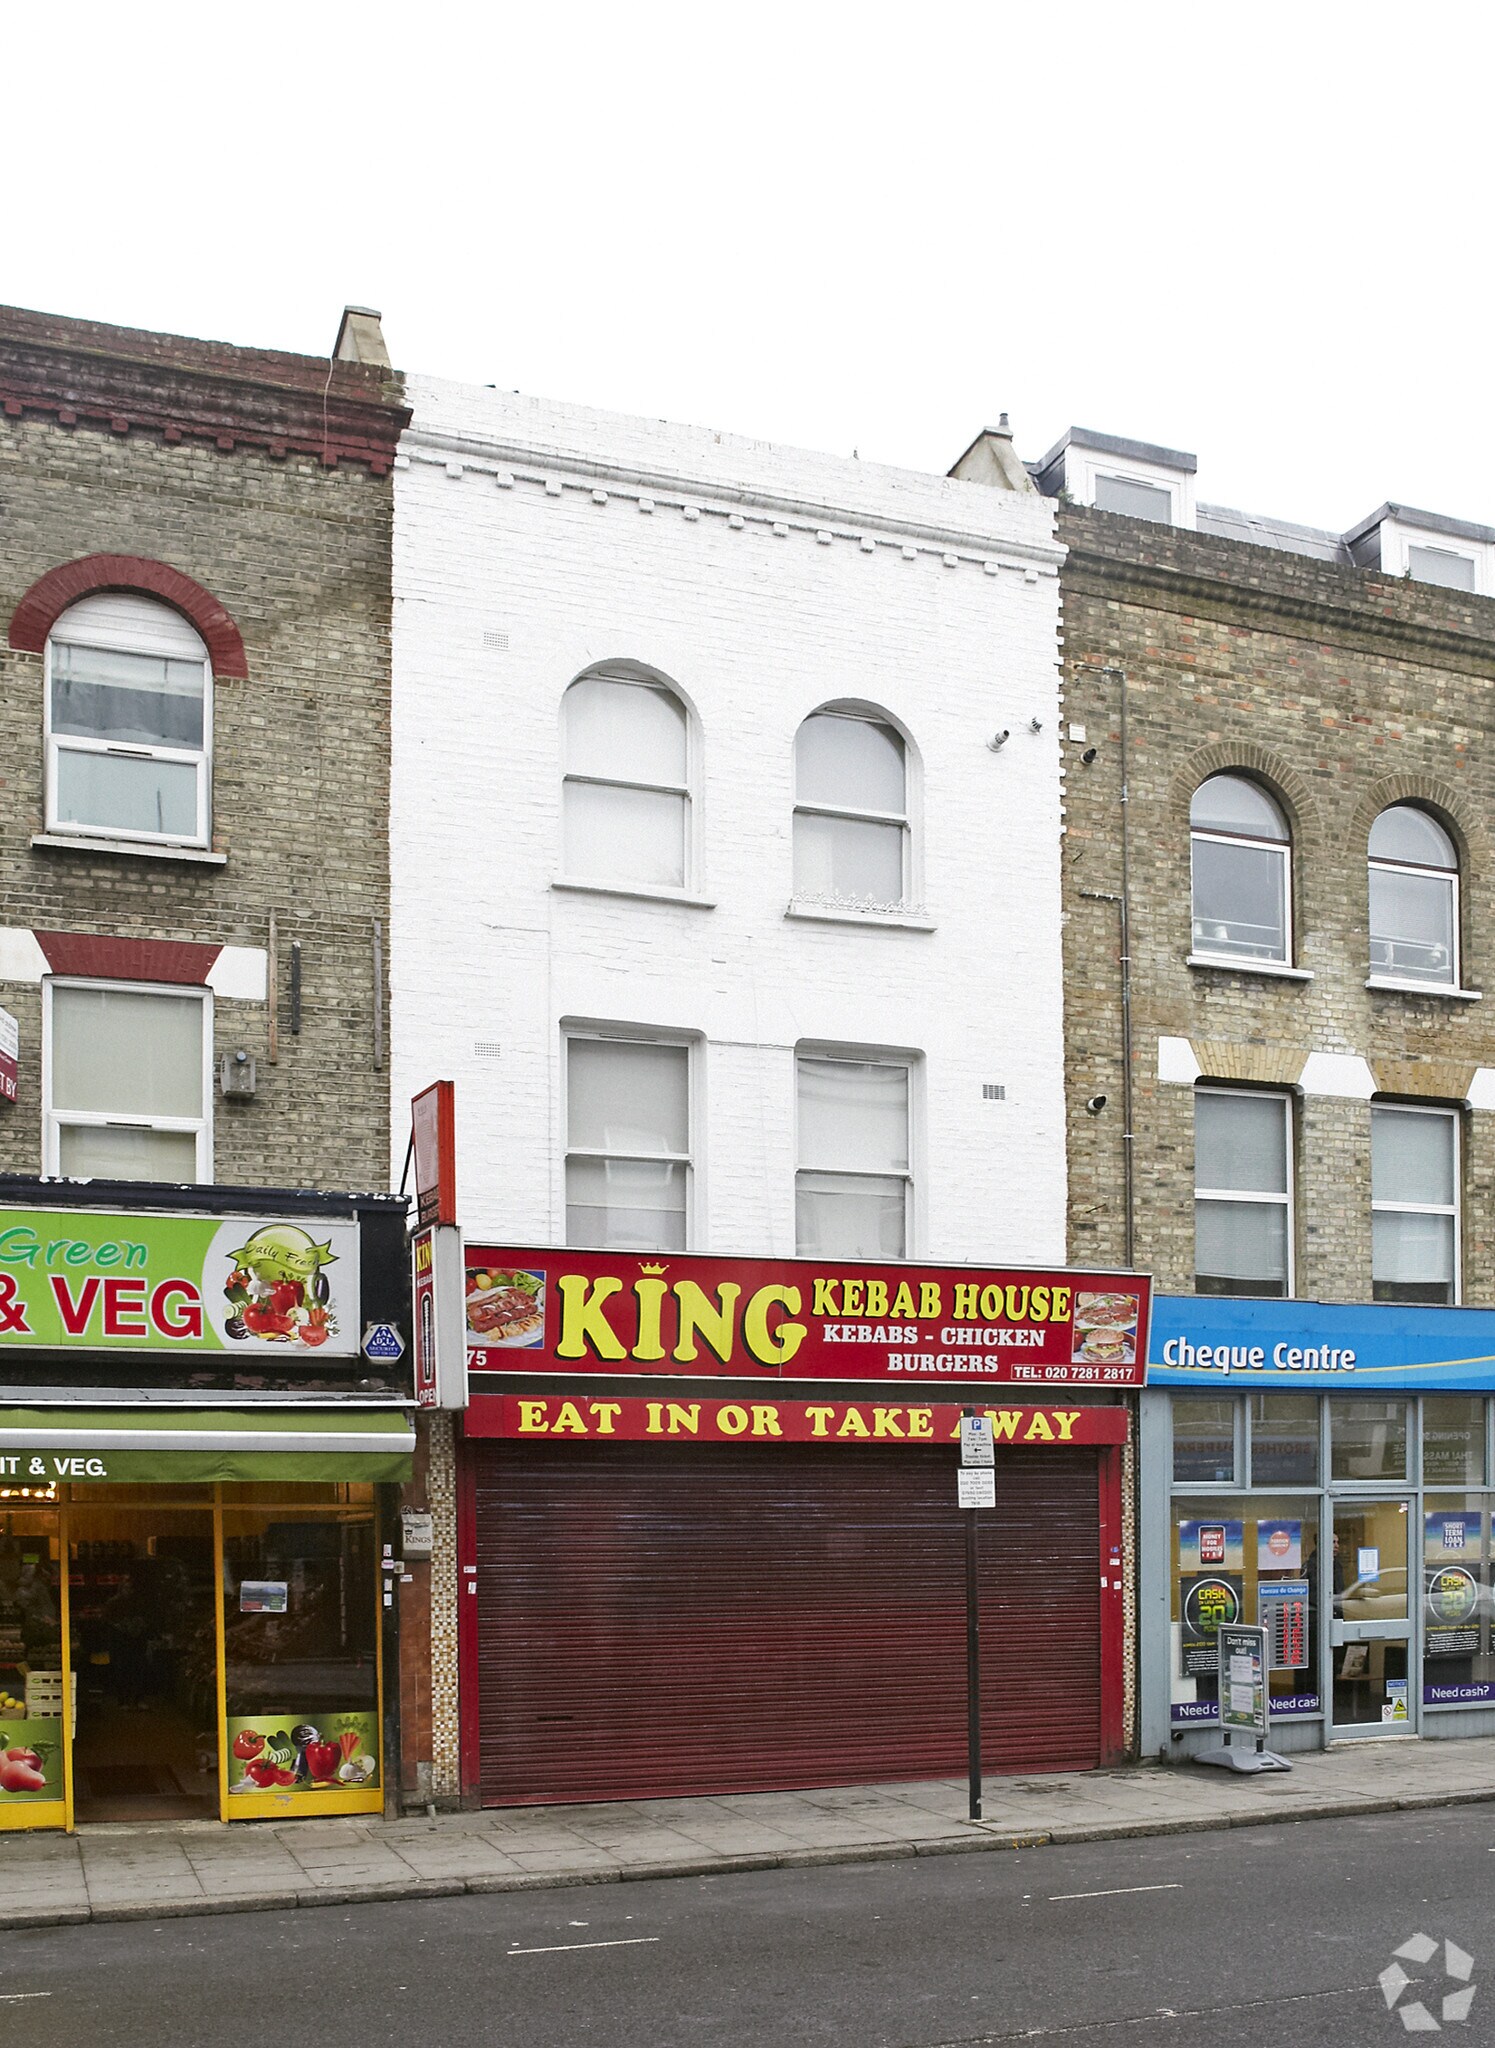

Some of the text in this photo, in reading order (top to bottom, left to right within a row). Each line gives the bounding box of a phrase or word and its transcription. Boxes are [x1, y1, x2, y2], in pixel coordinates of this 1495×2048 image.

[6, 1076, 17, 1098] BY
[0, 1226, 147, 1268] Green
[246, 1242, 279, 1262] Daily
[0, 1273, 203, 1338] & VEG
[812, 1278, 1071, 1323] KEBAB HOUSE
[557, 1274, 807, 1365] KING
[823, 1324, 918, 1345] KEBABS
[940, 1327, 1046, 1348] CHICKEN
[887, 1353, 998, 1373] BURGERS
[1163, 1337, 1355, 1375] Cheque Centre
[1014, 1365, 1133, 1381] TEL: 020 7281 2817
[517, 1401, 622, 1434] EAT
[646, 1402, 701, 1434] IN
[716, 1404, 783, 1437] OR
[805, 1406, 934, 1438] TAKE
[28, 1457, 46, 1475] &
[53, 1458, 107, 1476] VEG.
[1440, 1576, 1466, 1587] CASH
[1198, 1588, 1226, 1600] CASH
[1198, 1605, 1226, 1626] 20
[1227, 1636, 1242, 1646] Don't
[1242, 1638, 1257, 1647] miss
[1432, 1685, 1490, 1699] Need cash?
[1179, 1704, 1210, 1717] Need
[1269, 1697, 1296, 1710] Need
